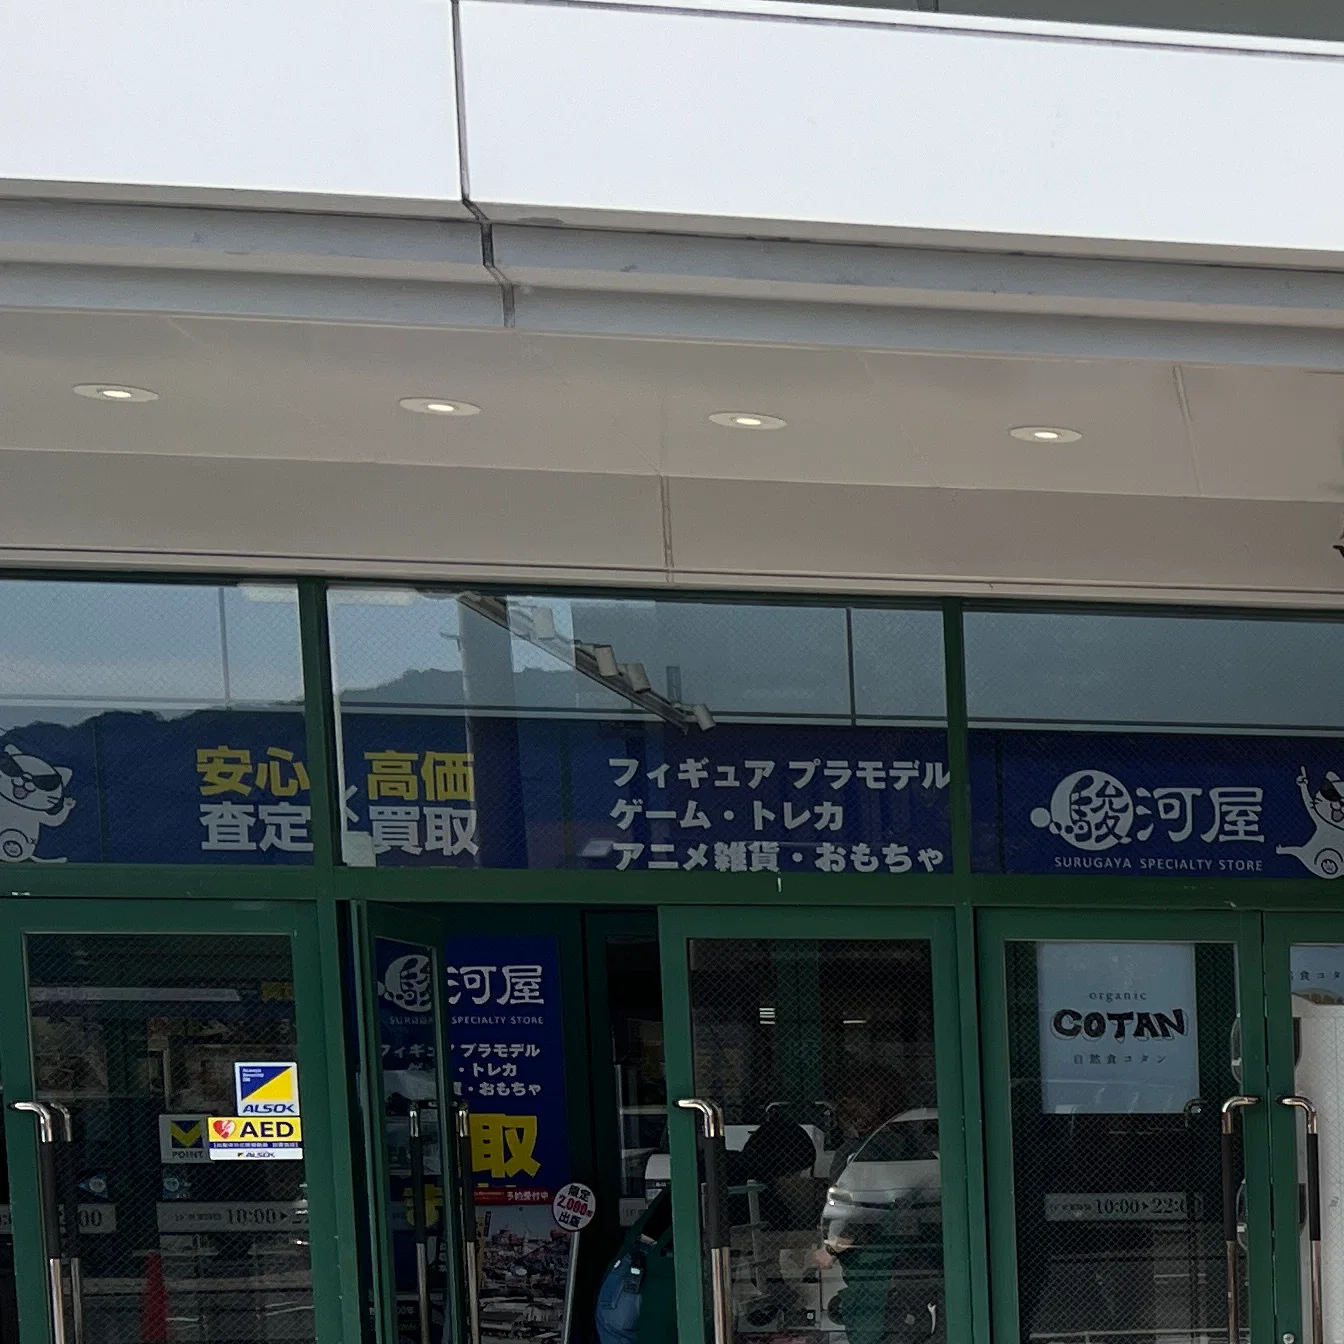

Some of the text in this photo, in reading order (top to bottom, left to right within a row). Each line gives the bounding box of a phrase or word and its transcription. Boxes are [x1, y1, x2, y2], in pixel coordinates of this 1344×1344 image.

[195, 745, 475, 802] 安心 高価
[608, 758, 951, 791] フィギュア プラモデル
[609, 798, 845, 832] ゲーム・トレカ
[200, 802, 314, 853] 査定
[368, 805, 480, 857] 買取
[612, 841, 944, 873] アニメ雑貨・おもちゃ
[1054, 856, 1264, 872] SURUGAYA SPECIALTY STORE
[1089, 990, 1148, 1003] organic
[451, 1015, 507, 1025] SPECIALTY
[510, 1015, 545, 1025] STORE
[1051, 1008, 1188, 1043] COTAN
[460, 1043, 541, 1059] プラモデル
[1073, 1053, 1167, 1065] 自然食コタン
[242, 1103, 295, 1114] ALSOK
[239, 1121, 295, 1138] AED
[469, 1113, 541, 1178] 取
